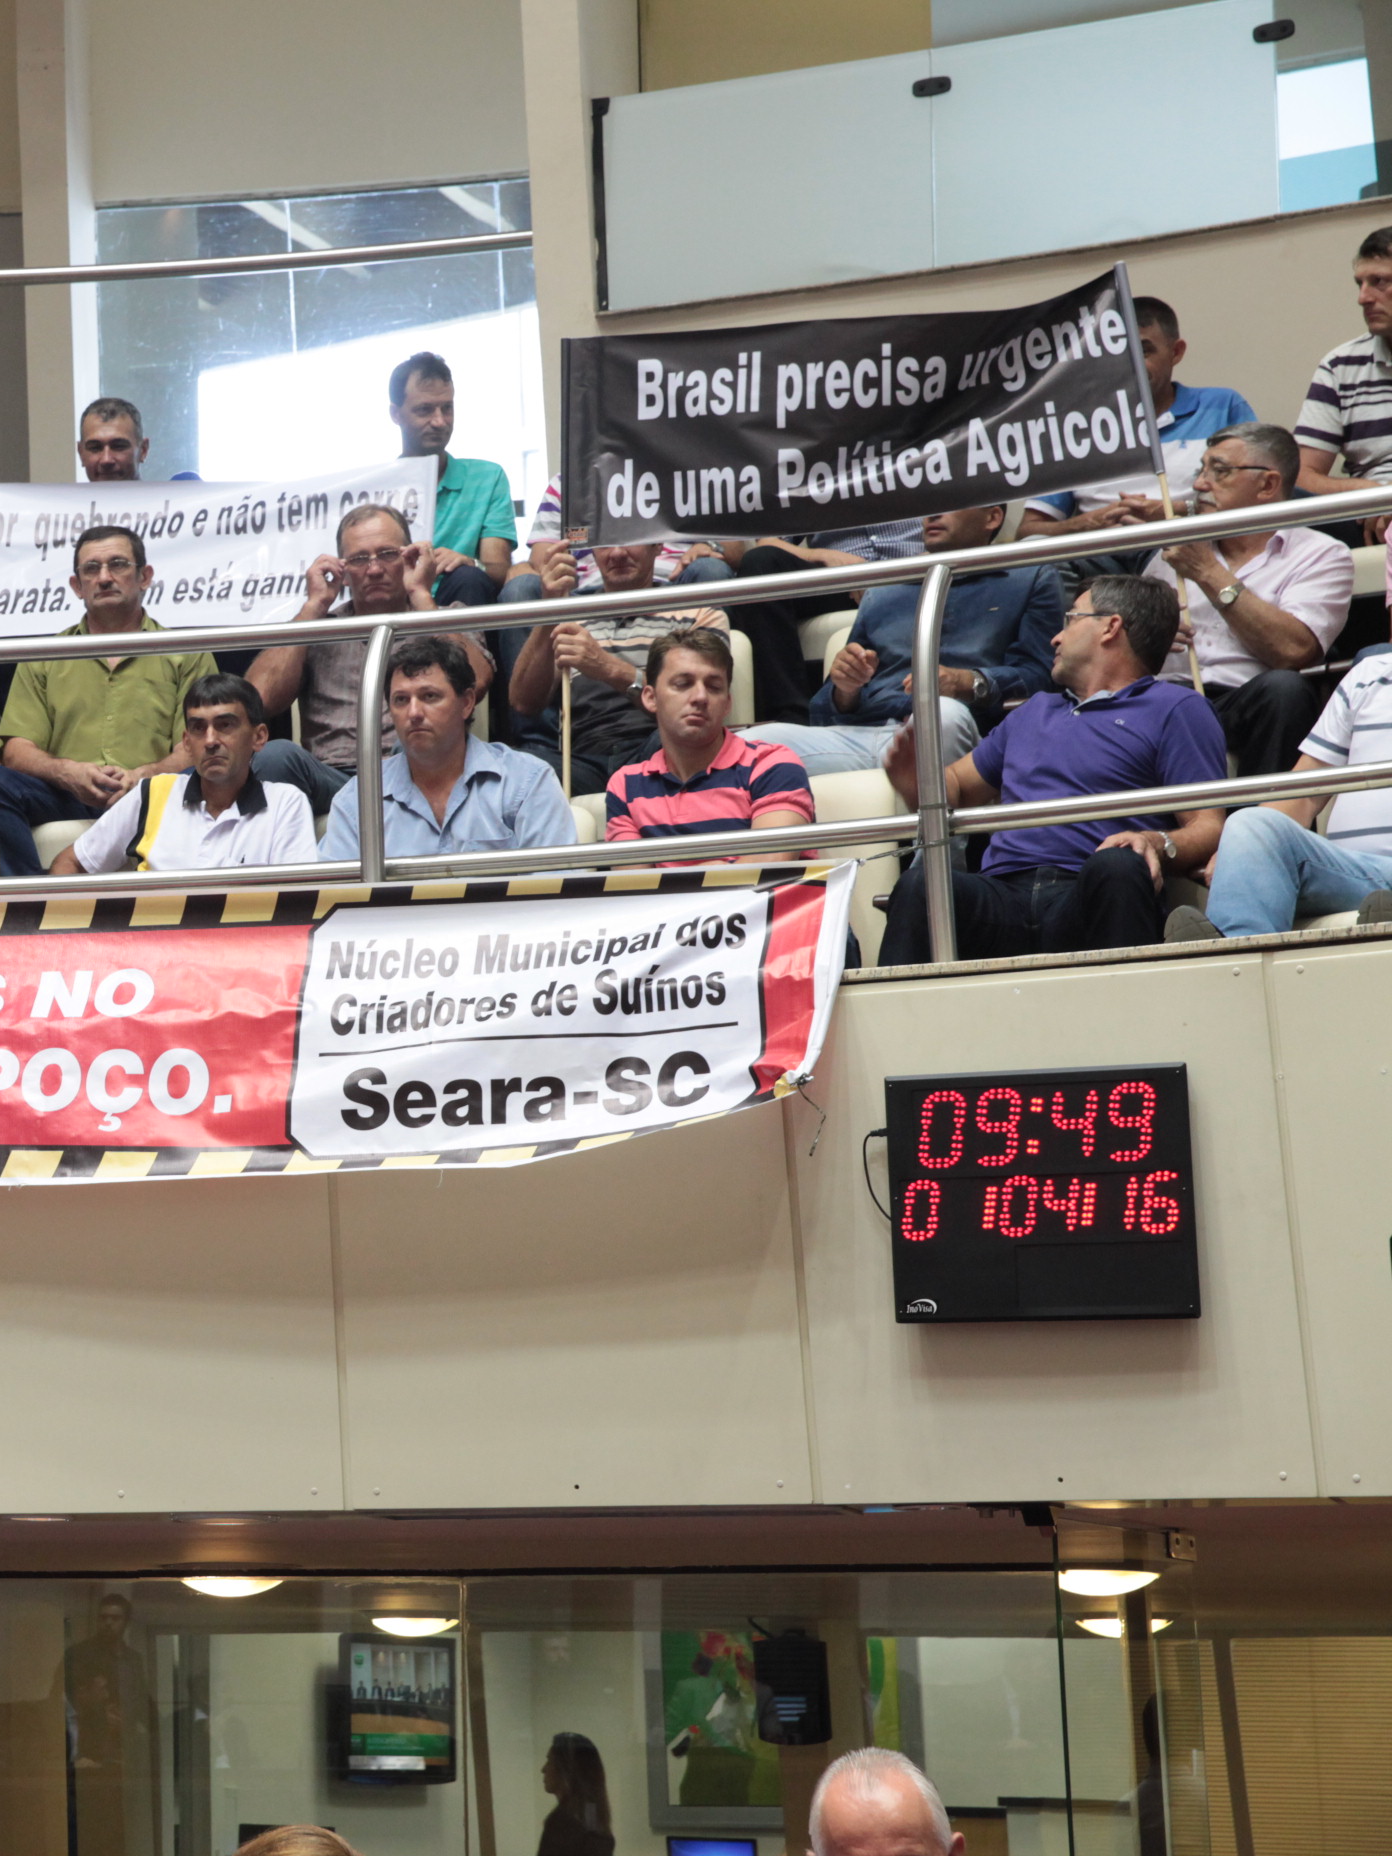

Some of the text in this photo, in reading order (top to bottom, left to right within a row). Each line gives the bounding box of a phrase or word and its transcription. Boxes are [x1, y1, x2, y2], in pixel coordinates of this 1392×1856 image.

[637, 306, 1127, 428] Brasil precisa urgente
[608, 459, 660, 518] de
[674, 464, 763, 517] uma
[777, 437, 952, 508] Política
[192, 504, 209, 537] e
[216, 494, 267, 536] não
[277, 491, 328, 533] tem
[172, 560, 233, 605] está
[325, 911, 747, 981] Núcleo Municipal dos
[30, 968, 155, 1019] NO
[329, 964, 727, 1036] Criadores de Suínos
[340, 1050, 711, 1131] Seara-SC
[918, 1081, 1156, 1169] 09:49
